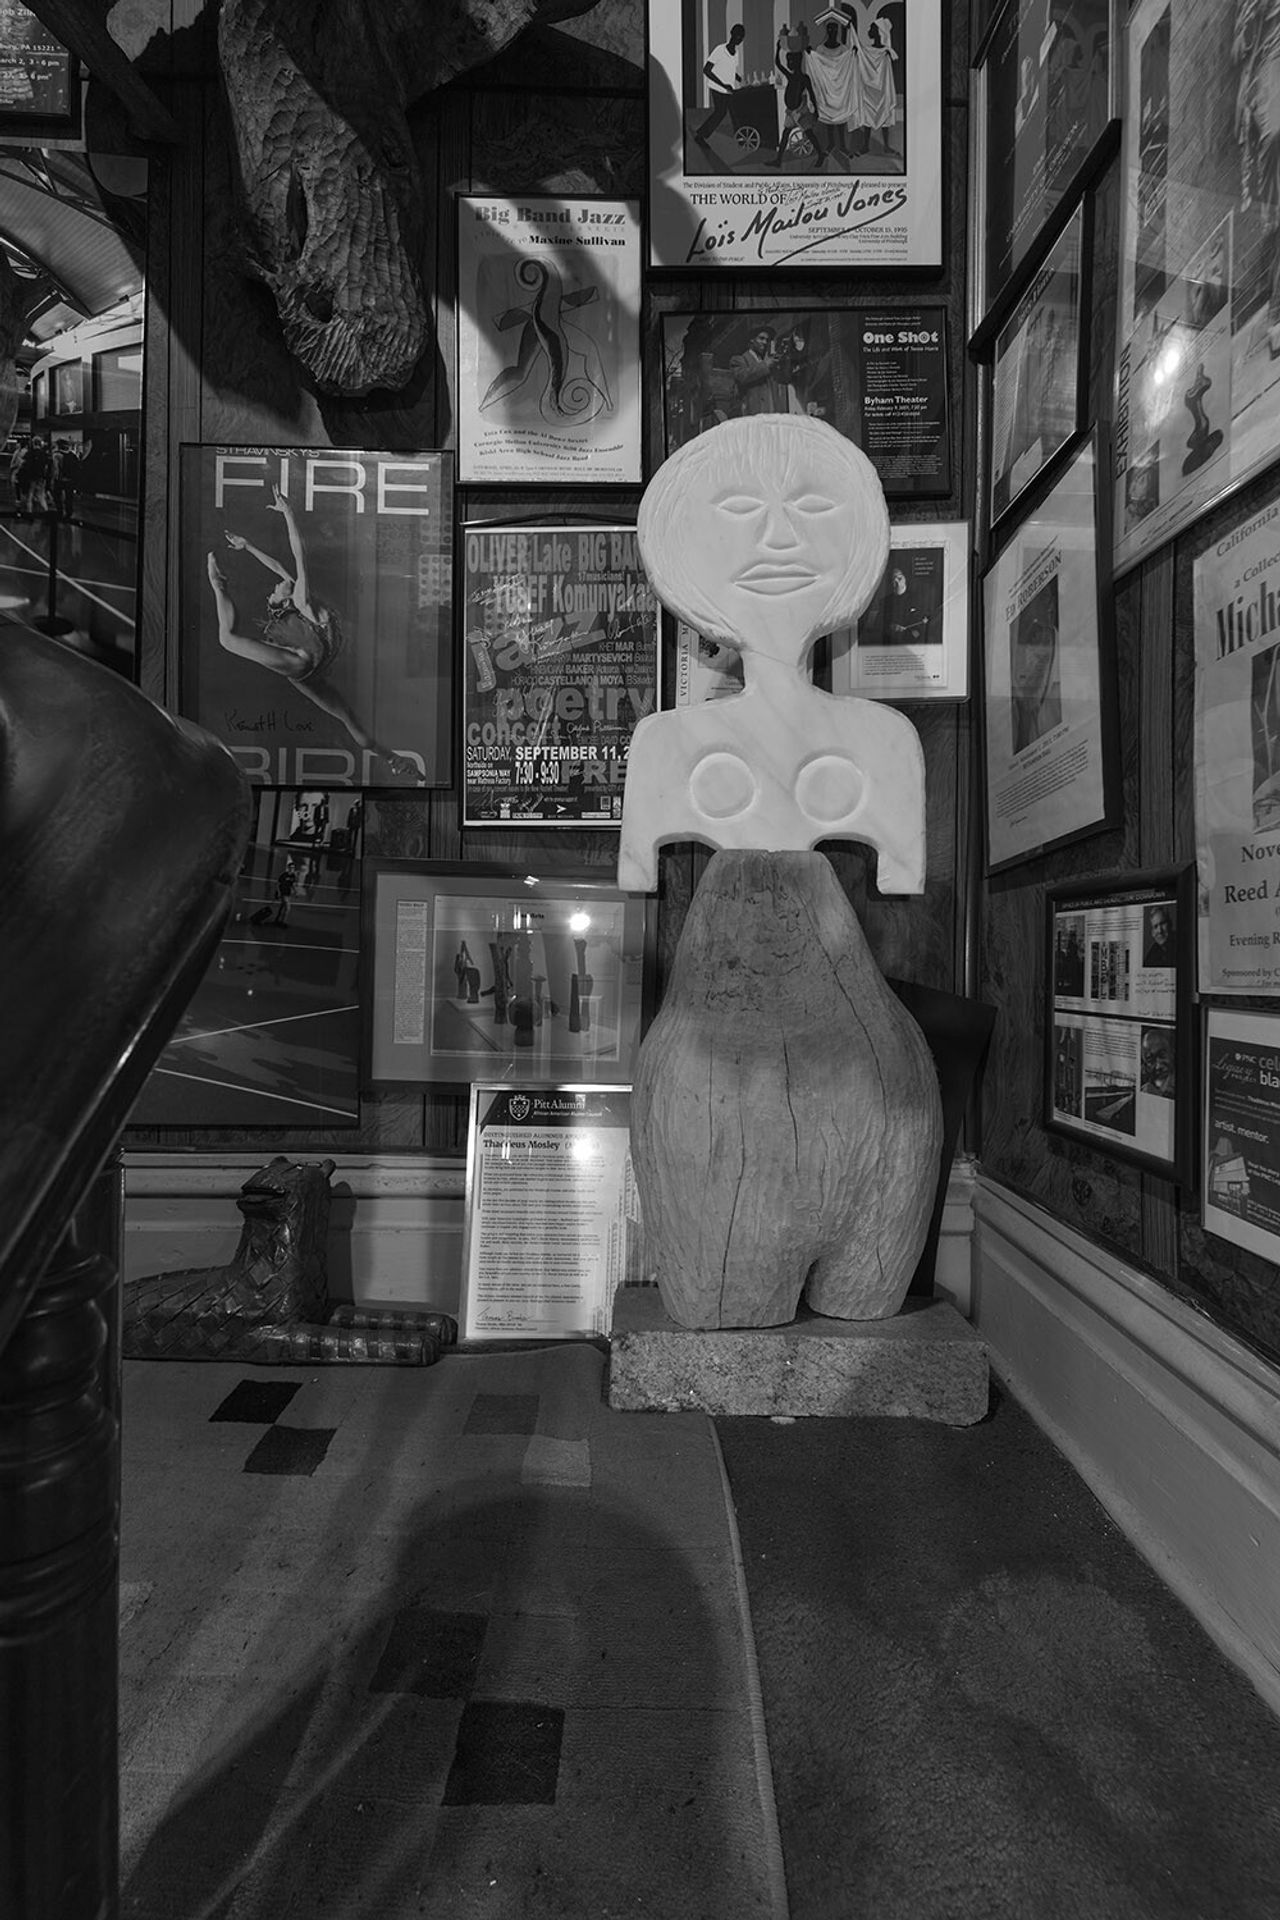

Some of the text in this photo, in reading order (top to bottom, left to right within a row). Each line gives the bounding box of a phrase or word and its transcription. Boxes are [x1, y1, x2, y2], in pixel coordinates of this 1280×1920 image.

[690, 193, 717, 205] THE
[719, 193, 768, 205] WORLD
[770, 193, 787, 205] OF
[836, 179, 908, 220] Jones
[476, 206, 626, 226] Big Band Jazz
[529, 236, 573, 246] Maxine
[576, 237, 626, 247] Sullivan
[862, 331, 894, 344] One
[894, 395, 928, 404] Theater
[1116, 342, 1131, 480] EXHIBITION
[215, 455, 430, 516] FIRE
[1216, 507, 1279, 557] California
[467, 533, 650, 573] OLIVER Lake BIG BAN
[493, 575, 548, 613] YUSEF
[565, 664, 595, 674] BAKER
[600, 675, 625, 686] MOYA
[496, 687, 657, 738] poetry
[467, 722, 562, 747] concert
[467, 746, 512, 762] SATURDAY,
[515, 746, 598, 760] SEPTEMBER
[515, 761, 534, 785] 7:30
[540, 761, 559, 785] 9:30
[561, 762, 627, 785] FRE
[1224, 880, 1269, 904] Reed
[1229, 933, 1271, 949] Evening
[1222, 968, 1261, 979] Sponsored
[534, 1099, 585, 1110] Pitt Alumni
[529, 1140, 560, 1151] Mosley
